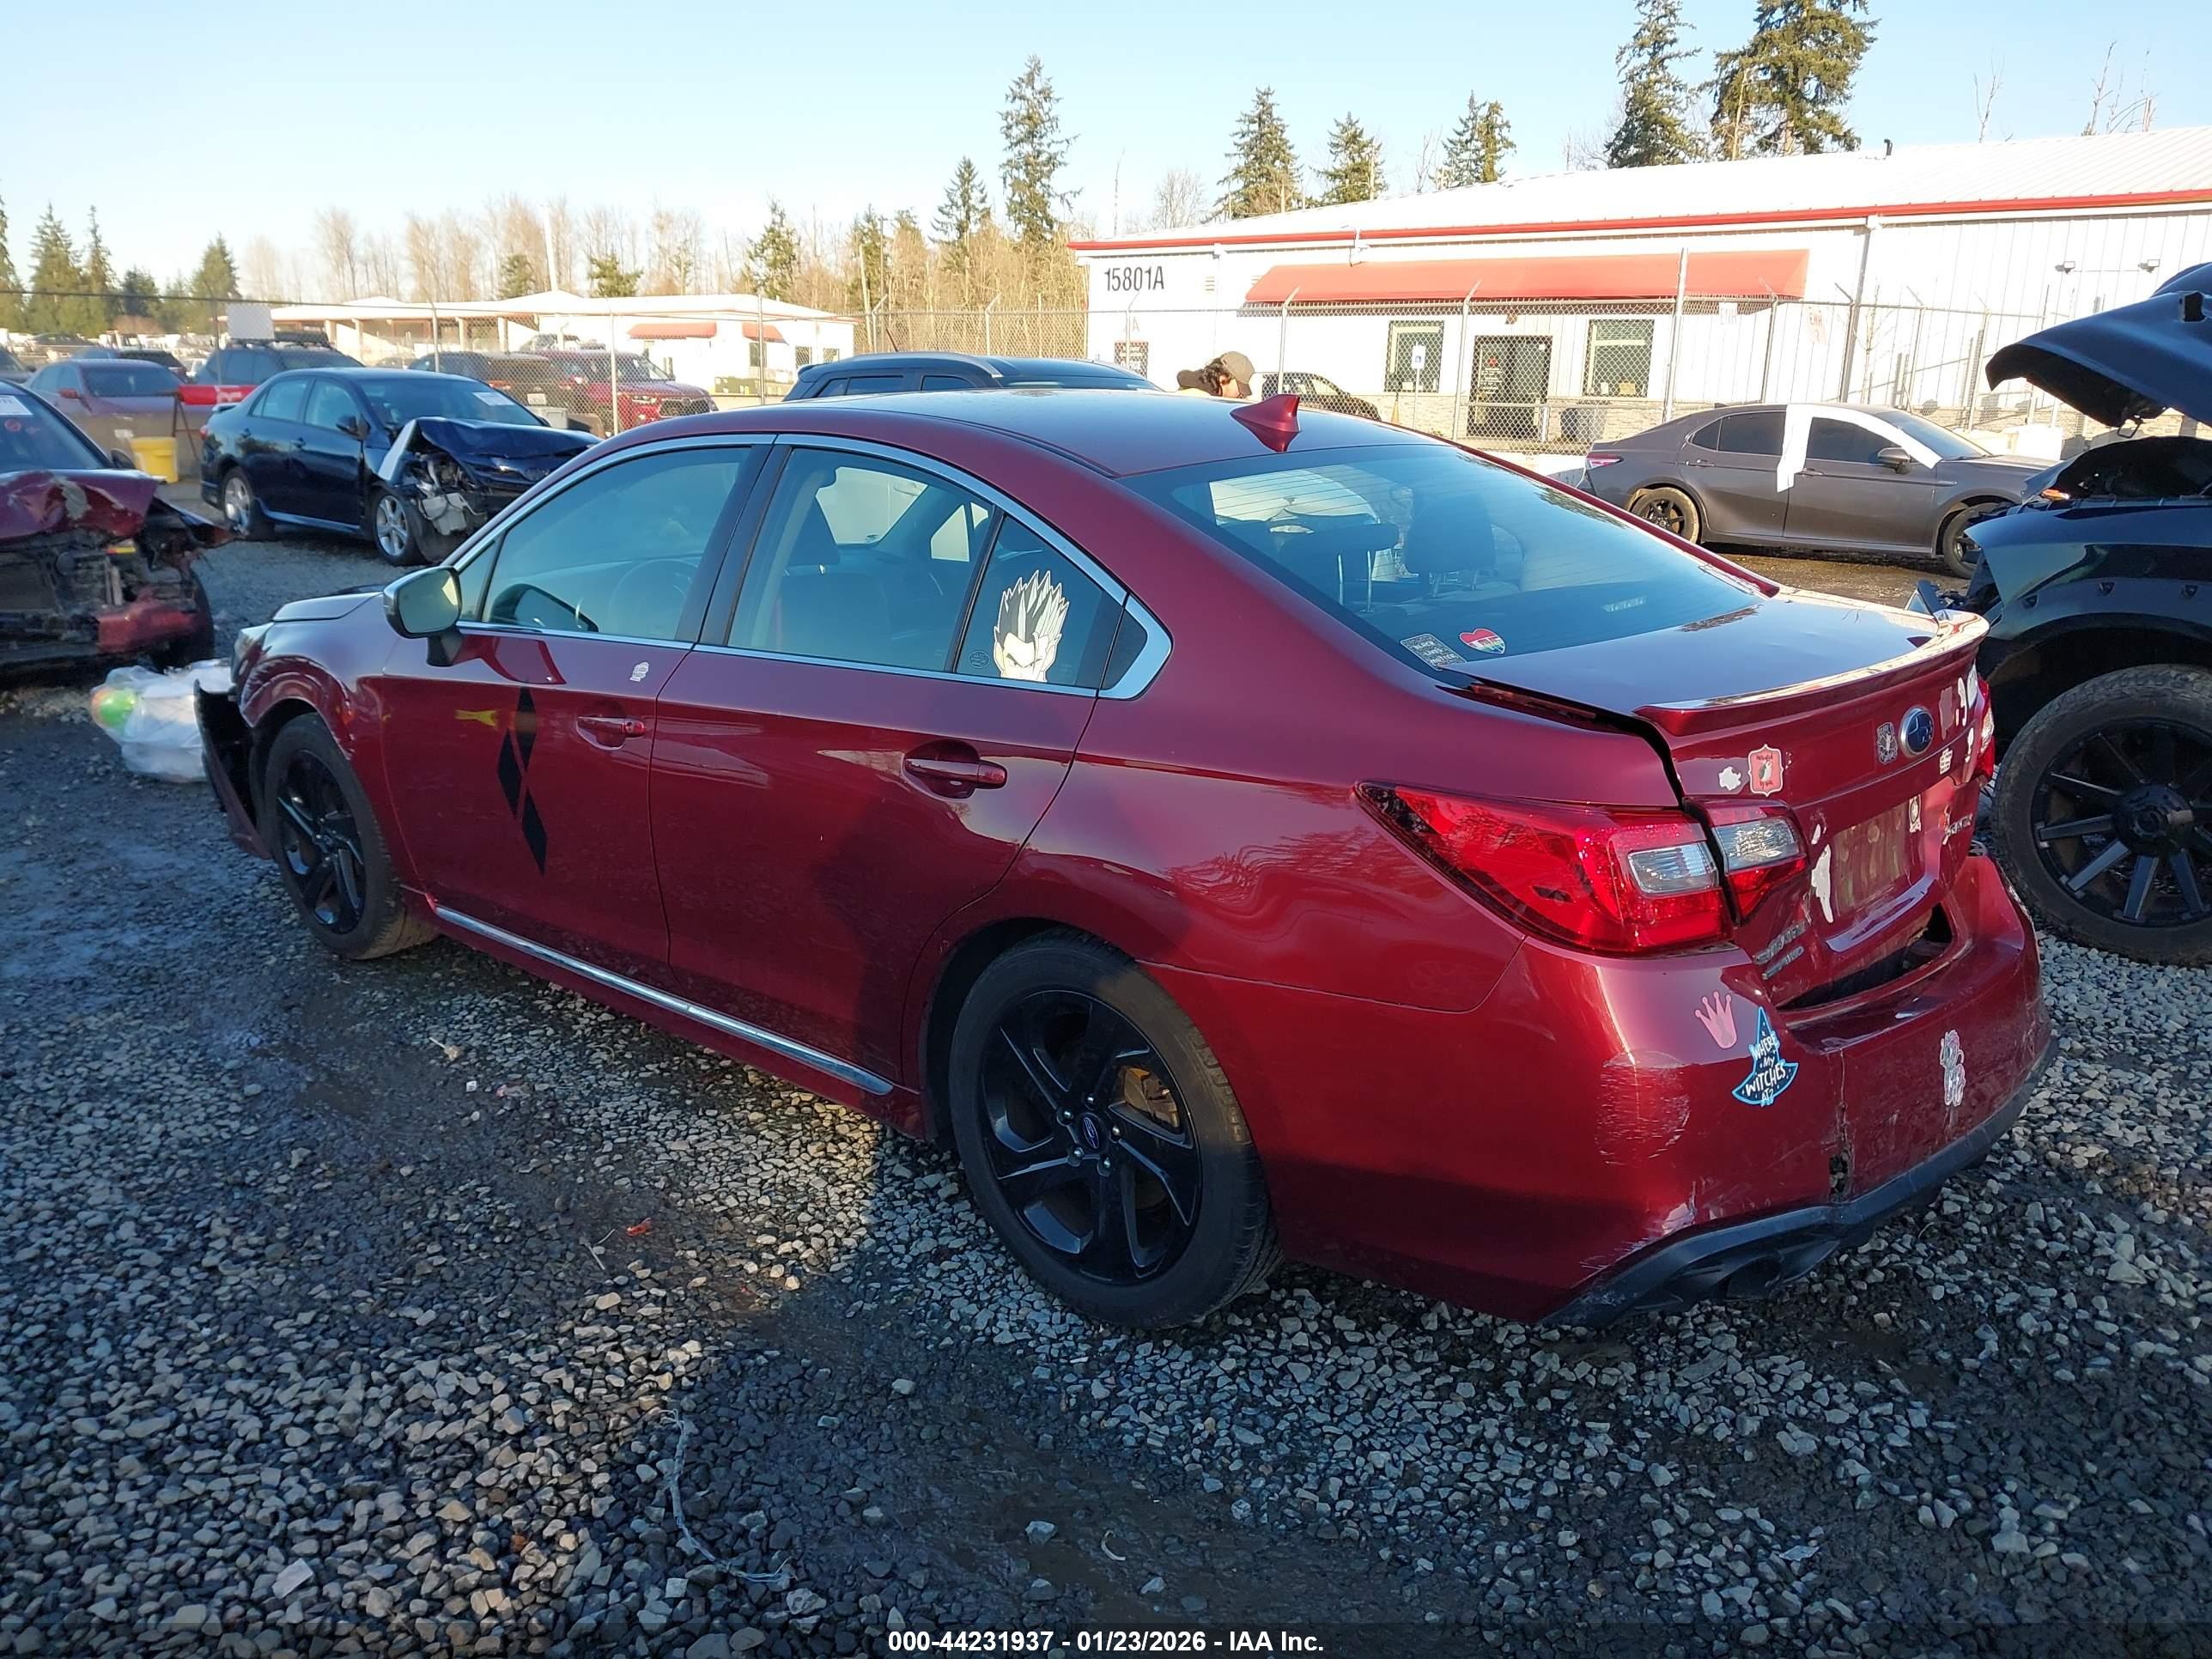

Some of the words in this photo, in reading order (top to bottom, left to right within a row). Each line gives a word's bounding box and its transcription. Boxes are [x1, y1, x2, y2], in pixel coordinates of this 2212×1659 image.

[1104, 266, 1164, 291] 15801A
[1750, 1031, 1779, 1060] WHERE
[1763, 1056, 1775, 1067] MY
[1746, 1061, 1786, 1097] WITCHES
